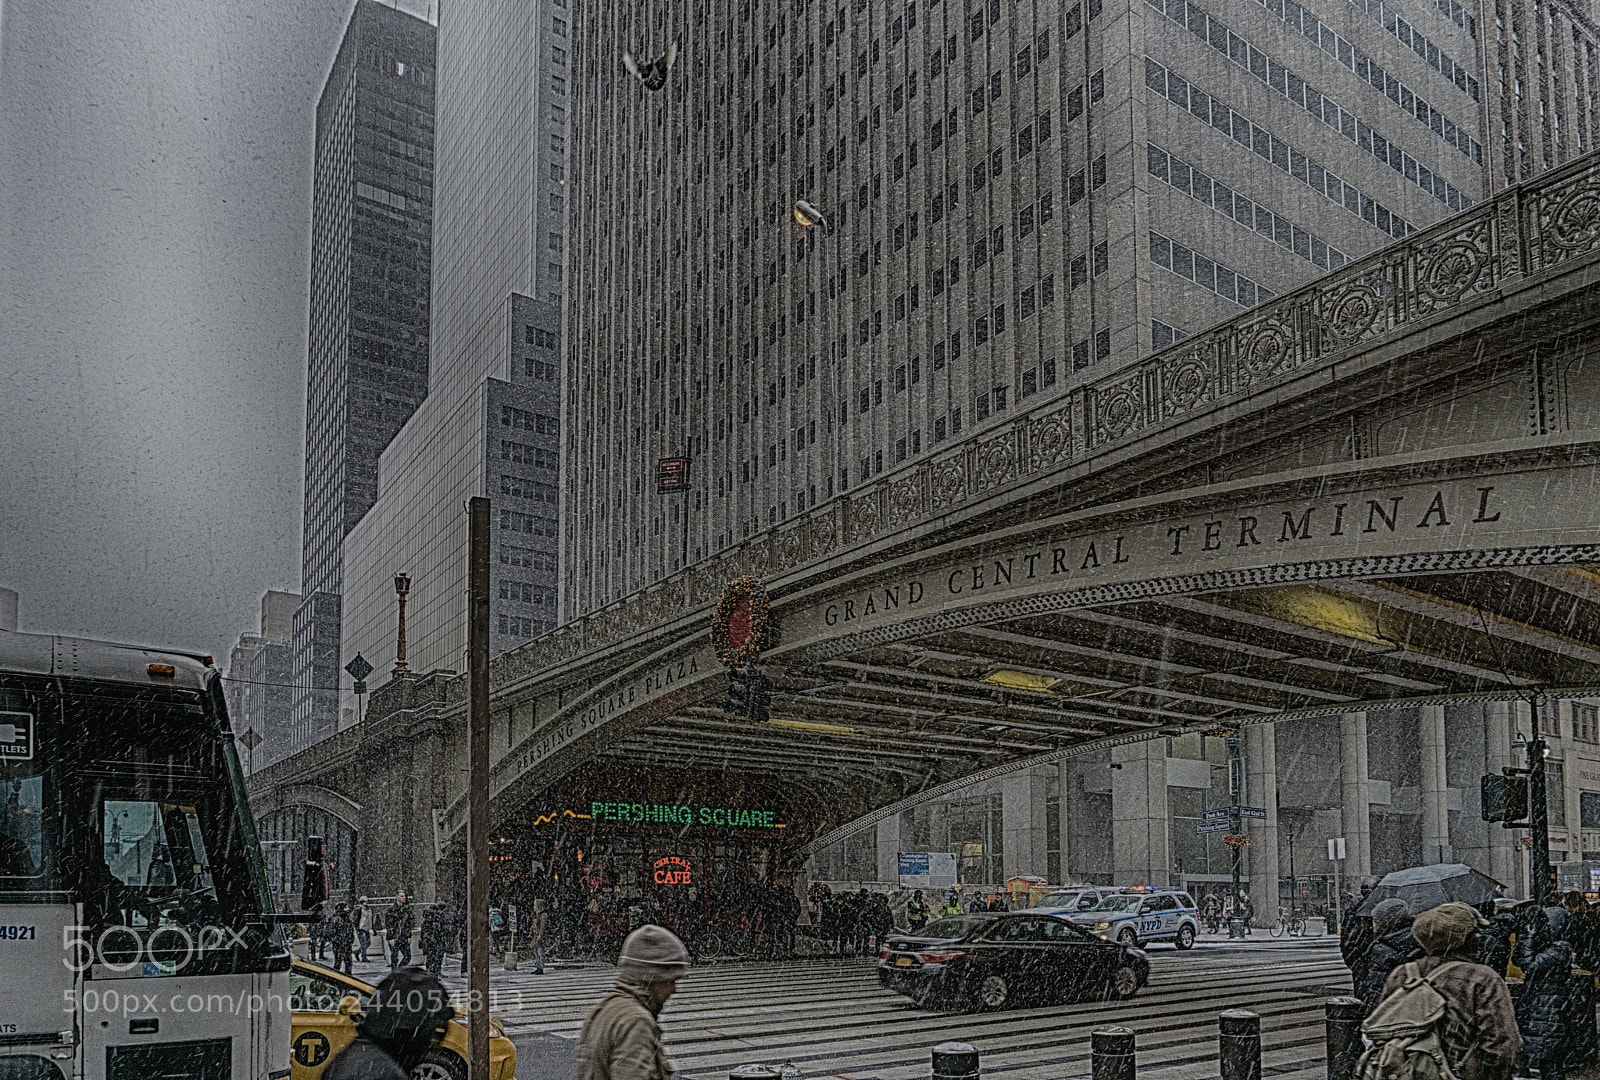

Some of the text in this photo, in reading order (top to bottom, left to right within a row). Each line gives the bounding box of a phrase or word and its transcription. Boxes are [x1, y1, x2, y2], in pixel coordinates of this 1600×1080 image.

[824, 486, 1502, 627] GRAND CENTRAL TERMINAL
[517, 655, 698, 774] PERSHING SQUARE PLAZA
[591, 801, 693, 824] PERSHING
[653, 856, 691, 872] CENTRAL
[654, 870, 691, 885] CAFE
[0, 925, 36, 940] 4921
[1139, 920, 1162, 932] NYPD
[301, 1038, 322, 1063] T
